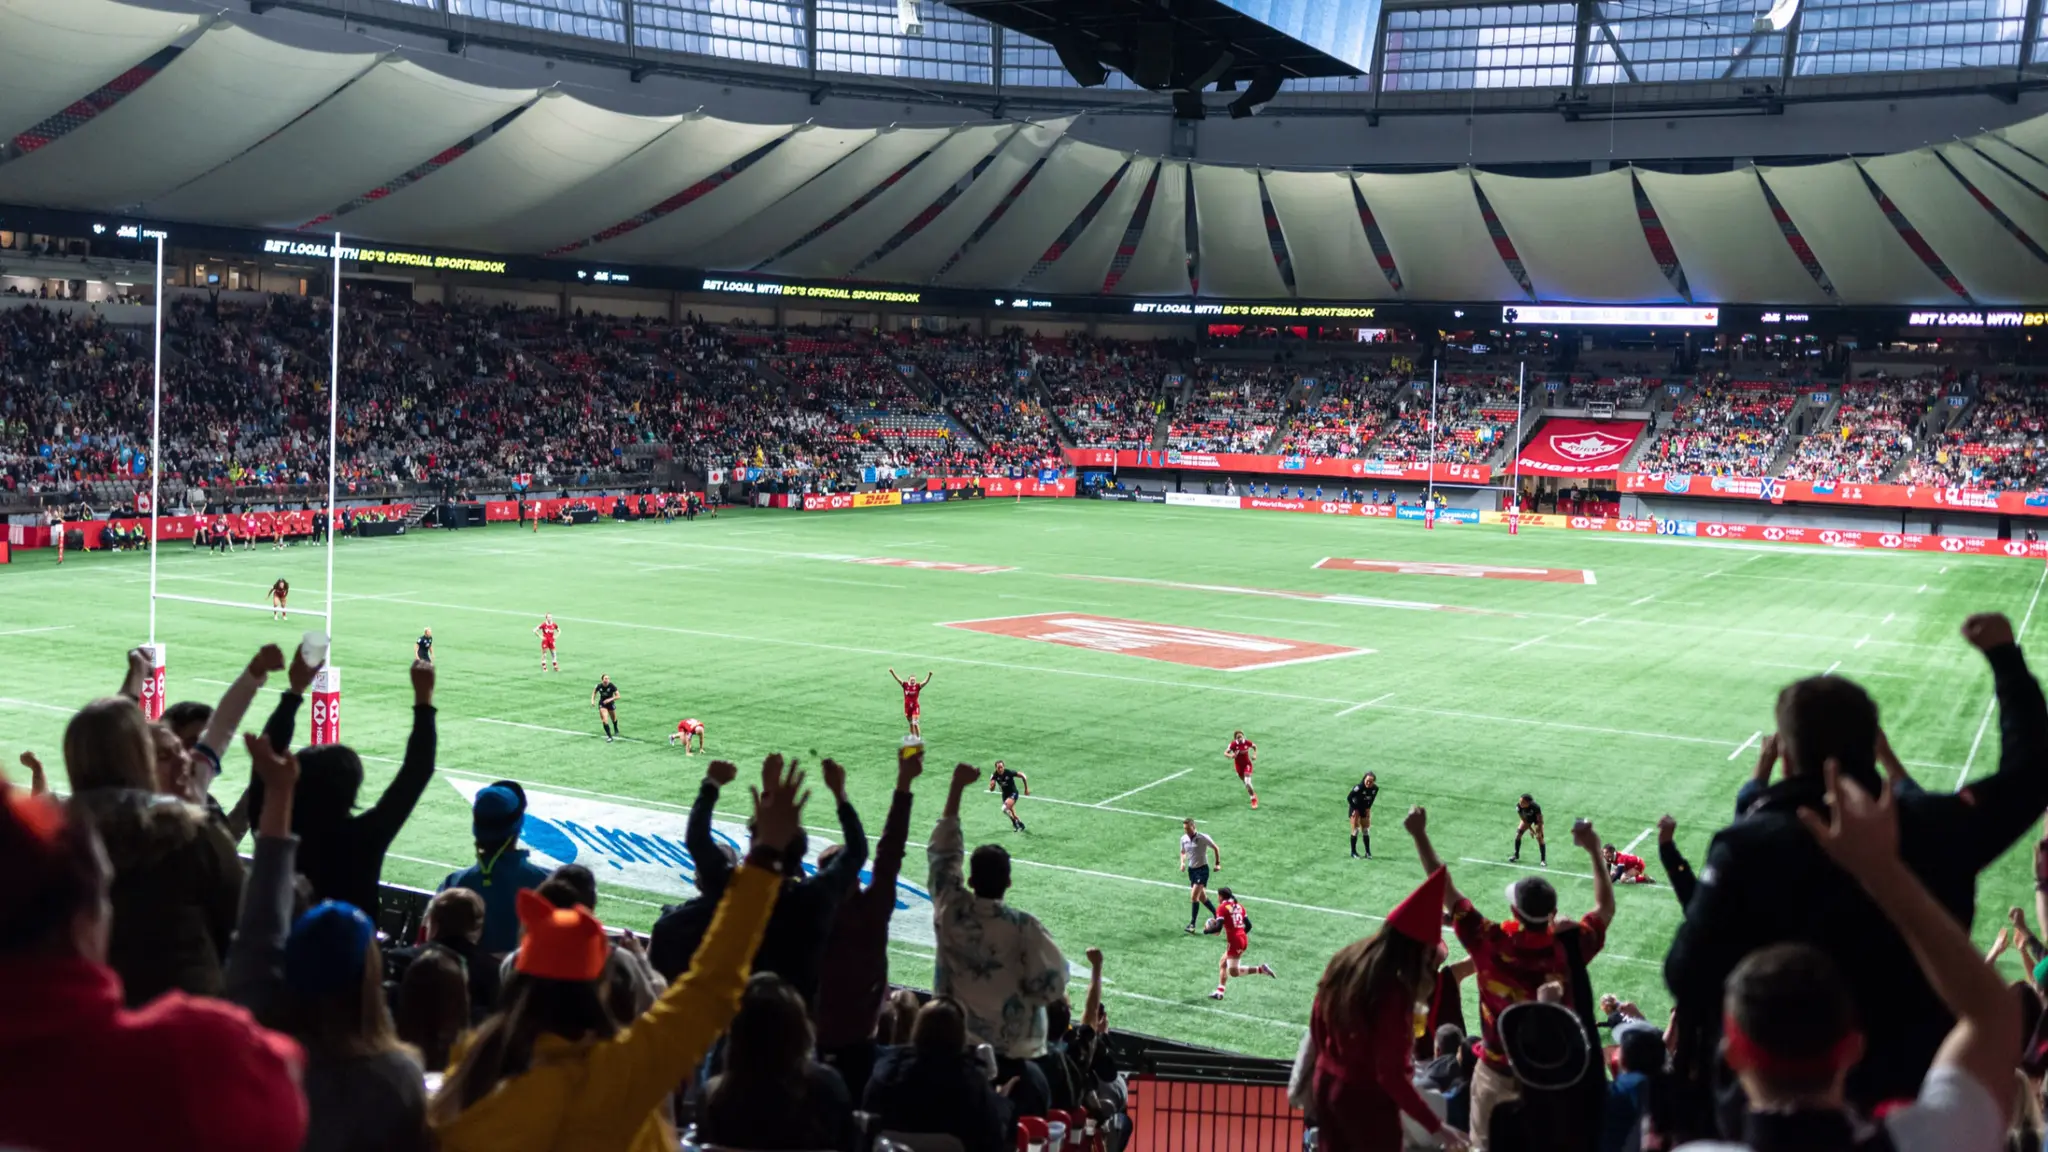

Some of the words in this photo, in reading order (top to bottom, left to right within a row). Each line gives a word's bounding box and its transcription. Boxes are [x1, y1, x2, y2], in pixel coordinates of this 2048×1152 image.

[143, 229, 167, 239] SPORTS
[264, 239, 290, 253] BET
[290, 242, 328, 257] LOCAL
[359, 249, 386, 262] BC'S
[386, 252, 433, 267] OFFICIAL
[434, 256, 506, 273] SPORTSBOOK
[702, 280, 723, 290] BET
[723, 281, 755, 293] LOCAL
[756, 283, 783, 295] WITH
[783, 285, 807, 296] BC'S
[807, 287, 850, 299] OFFICIAL
[851, 290, 920, 303] SPORTSBOOK
[1133, 303, 1156, 312] BET
[1156, 304, 1192, 314] LOCAL
[1194, 305, 1223, 315] WITH
[1223, 306, 1249, 315] BC'S
[1250, 306, 1299, 316] OFFICIAL
[1300, 307, 1375, 318] SPORTSBOOK
[1909, 312, 1938, 325] BET
[1938, 312, 1984, 325] LOCAL
[1987, 312, 2023, 326] WITH
[864, 494, 891, 505] DHL
[1656, 519, 1676, 535] 30
[1965, 539, 1985, 547] HSBC
